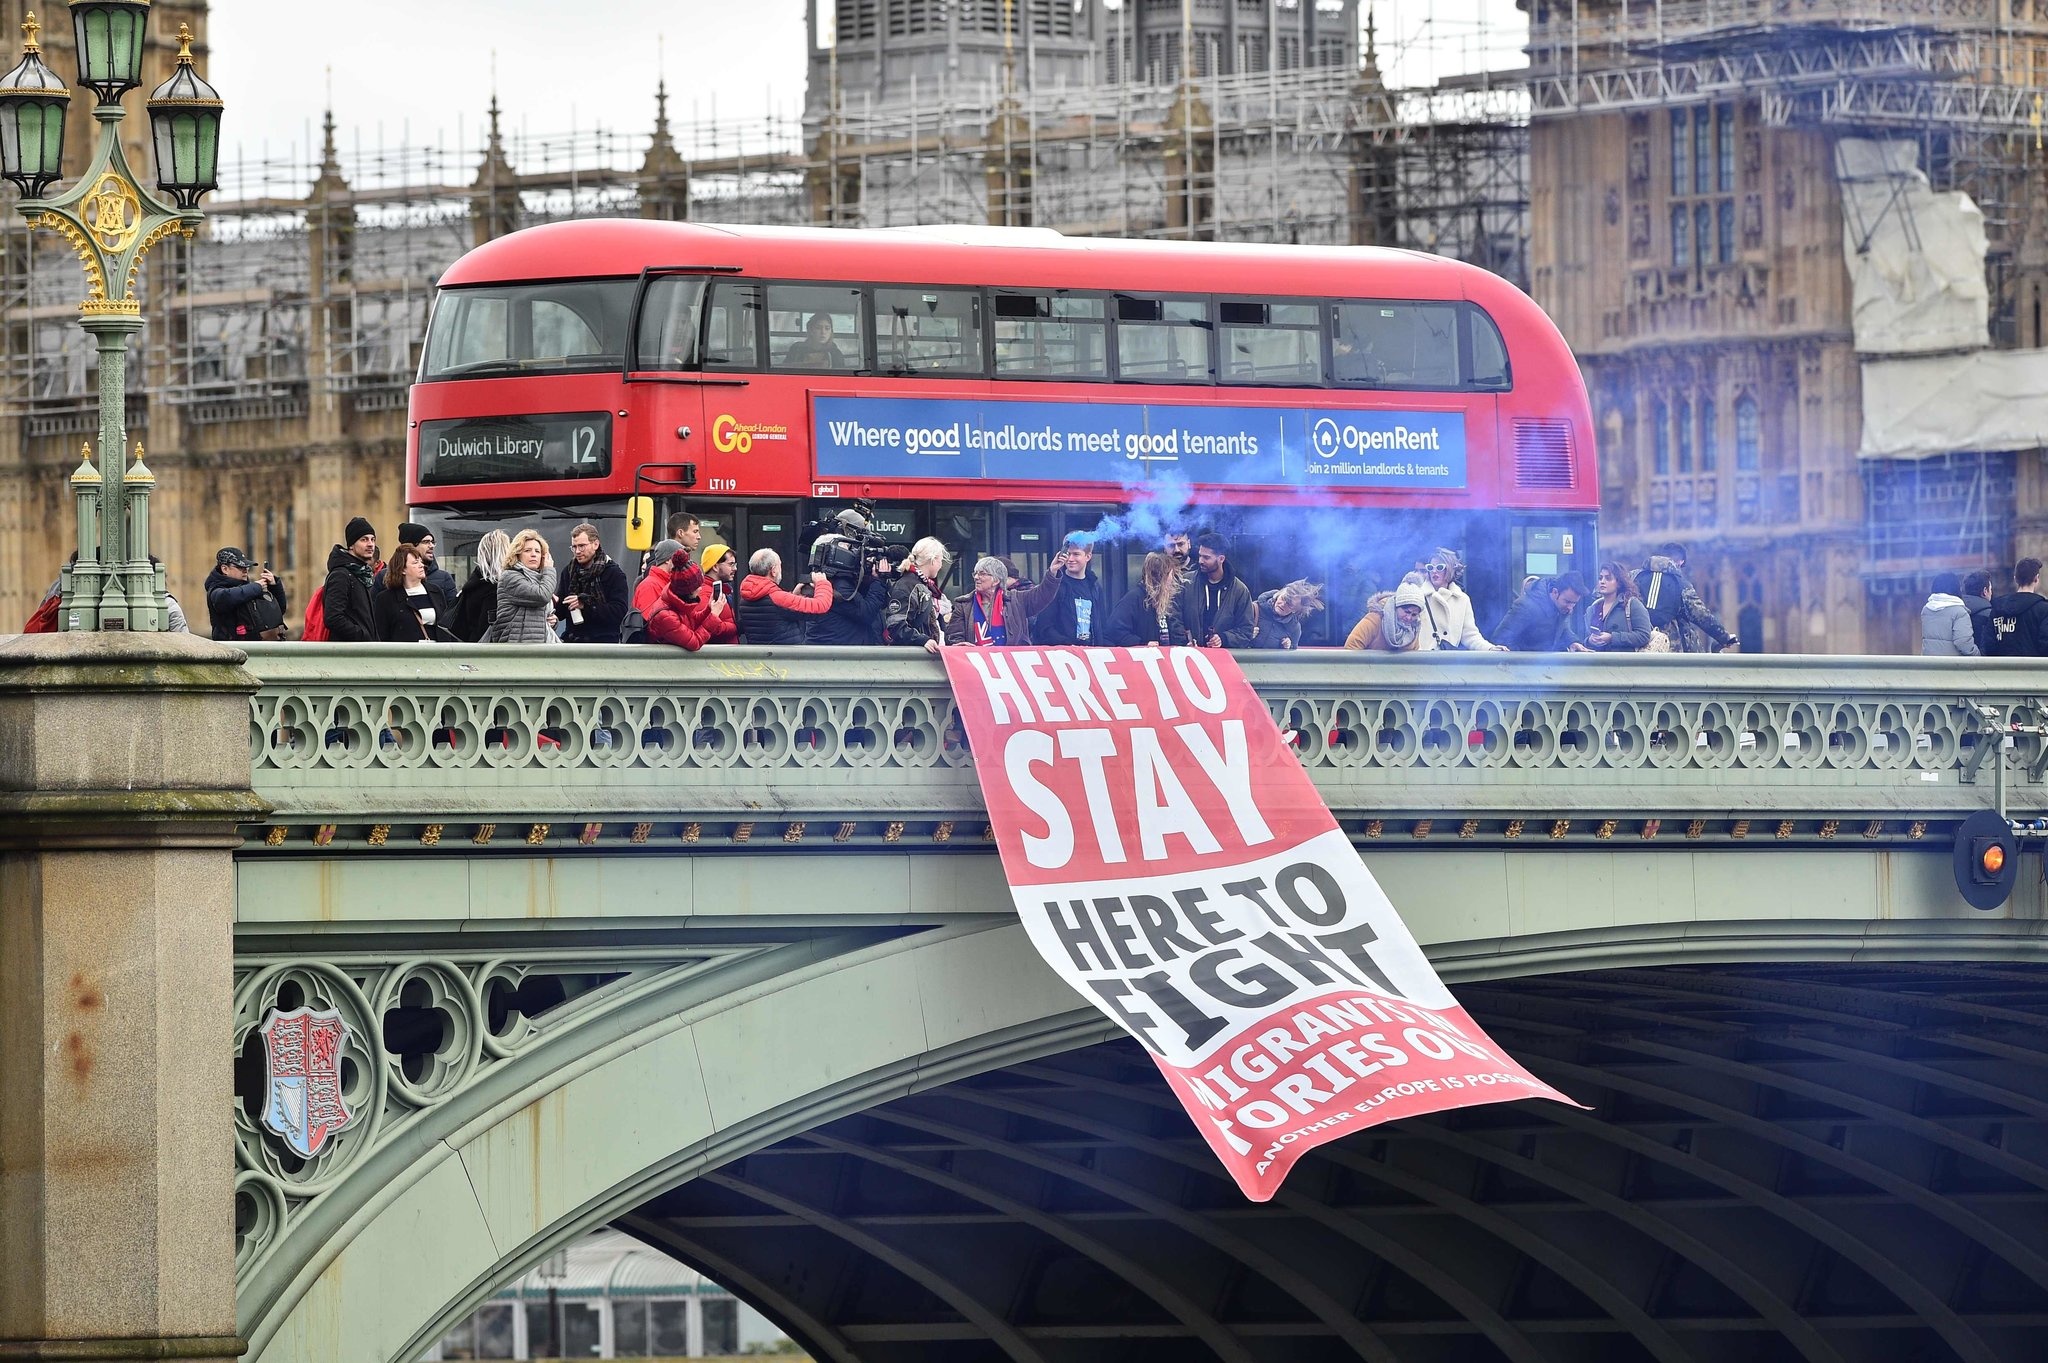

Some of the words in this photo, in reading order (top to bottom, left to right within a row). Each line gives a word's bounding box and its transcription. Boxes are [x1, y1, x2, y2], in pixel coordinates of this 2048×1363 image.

[439, 437, 492, 457] Dulwich
[496, 436, 544, 459] Library
[572, 426, 597, 464] 12
[712, 414, 752, 453] Go
[734, 423, 787, 433] Ahead-London
[829, 421, 900, 447] Where
[905, 423, 960, 455] good
[964, 423, 1062, 451] landlords
[1067, 428, 1121, 452] meet
[1125, 428, 1179, 460] good
[1182, 430, 1258, 455] tenants
[1343, 425, 1440, 455] OpenRent
[709, 478, 737, 490] LT119
[1304, 462, 1323, 474] oin
[1323, 464, 1330, 474] 2
[1331, 462, 1362, 475] million
[1363, 463, 1406, 476] landlords
[1407, 464, 1414, 475] &
[1415, 464, 1449, 476] tenants
[876, 520, 906, 534] Library
[966, 648, 1142, 725] HERE
[1132, 646, 1227, 720] TO
[1004, 719, 1275, 869] STAY
[1045, 886, 1246, 972] HERE
[1221, 862, 1347, 927] TO
[1086, 922, 1408, 1057] FIGHT
[1180, 998, 1416, 1111] MIGRANTS
[1255, 1111, 1355, 1176] ANOTHER
[1353, 1079, 1442, 1113] EUROPE
[1439, 1076, 1465, 1089] IS
